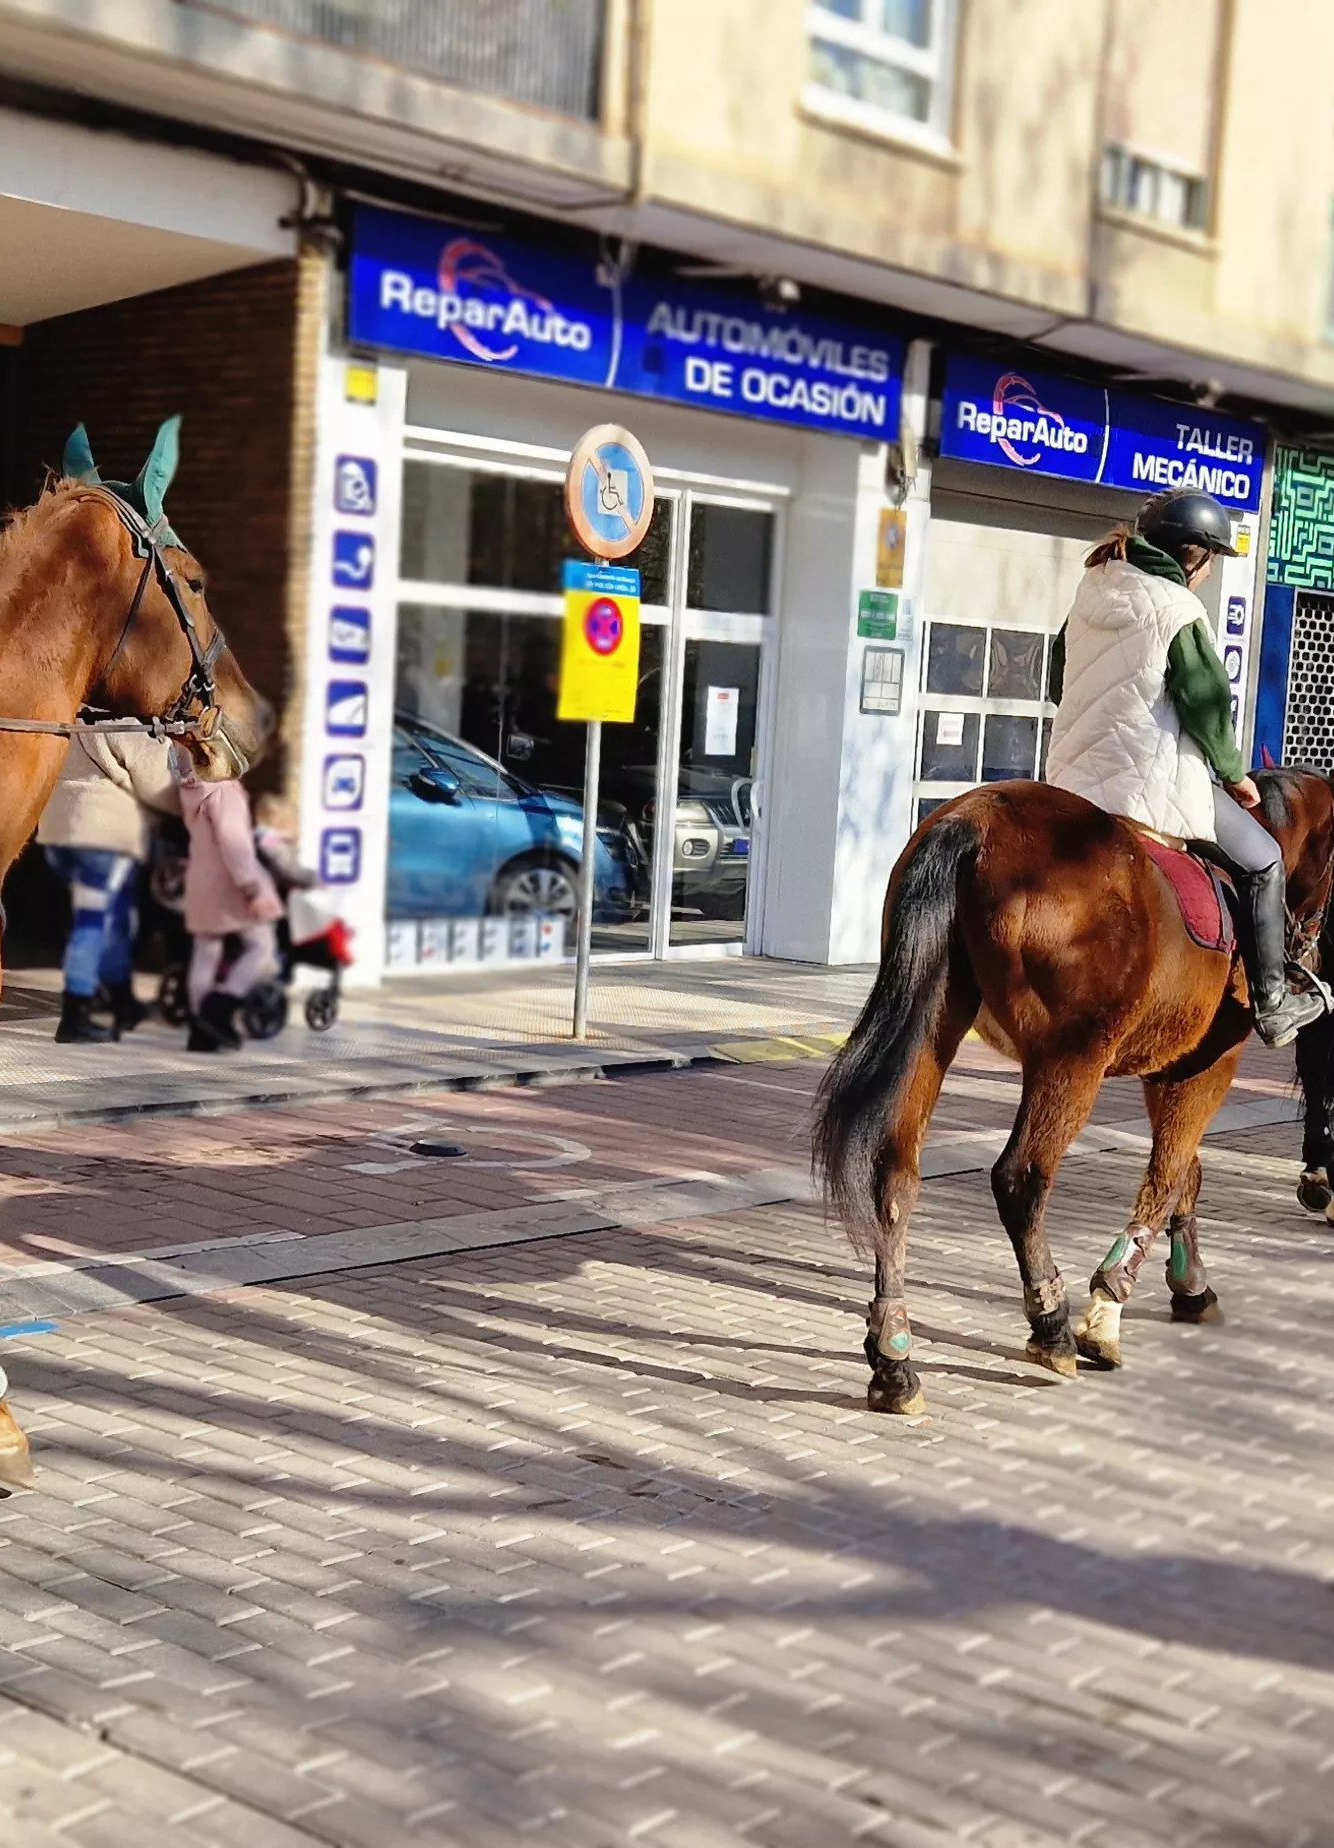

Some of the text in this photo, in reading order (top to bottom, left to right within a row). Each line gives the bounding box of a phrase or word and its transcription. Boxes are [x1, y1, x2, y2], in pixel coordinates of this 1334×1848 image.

[380, 269, 592, 351] ReparAuto
[647, 301, 889, 382] AUTOMÓVILES
[685, 356, 886, 426] DE OCASIÓN
[957, 401, 1088, 454] ReparAuto
[1176, 422, 1254, 465] TALLER
[1132, 452, 1251, 500] MECÁNICO
